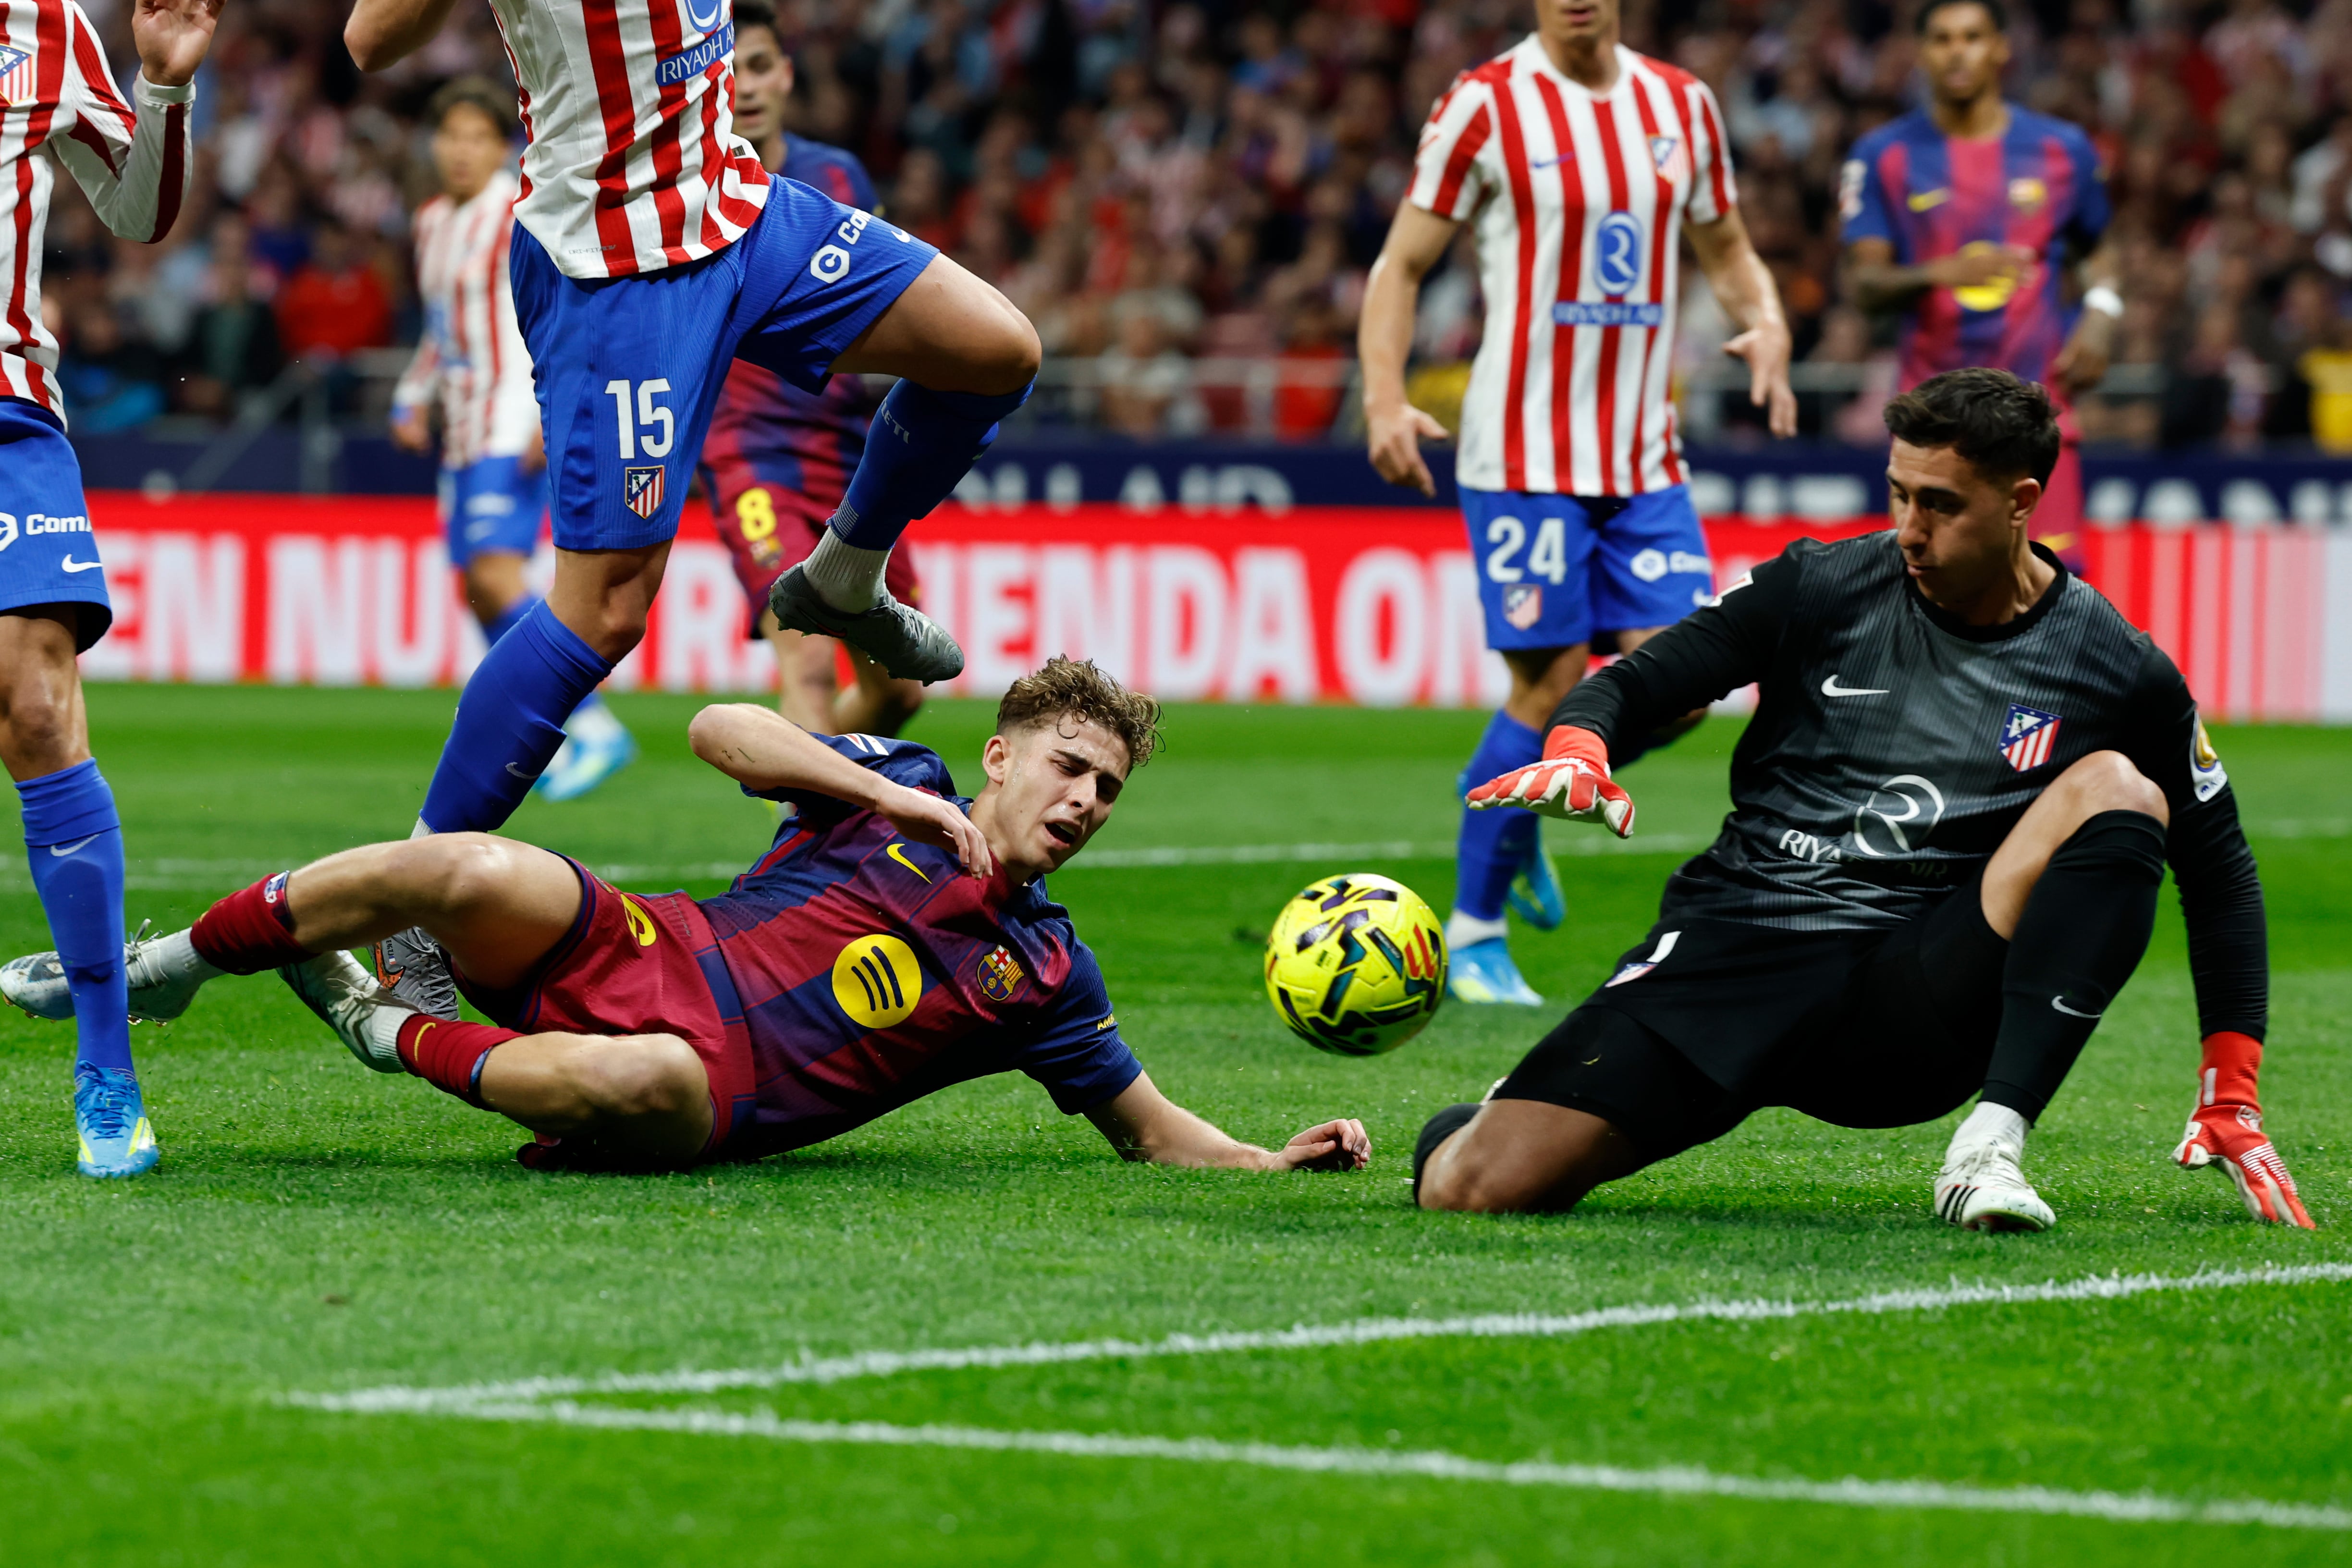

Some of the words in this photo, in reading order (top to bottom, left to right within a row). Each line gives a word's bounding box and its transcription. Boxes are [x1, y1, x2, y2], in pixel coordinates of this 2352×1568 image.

[662, 33, 723, 83] RIYADH
[604, 377, 674, 459] 15
[736, 487, 777, 542] 8
[1487, 514, 1568, 586] 24
[909, 541, 1320, 704] IENDA
